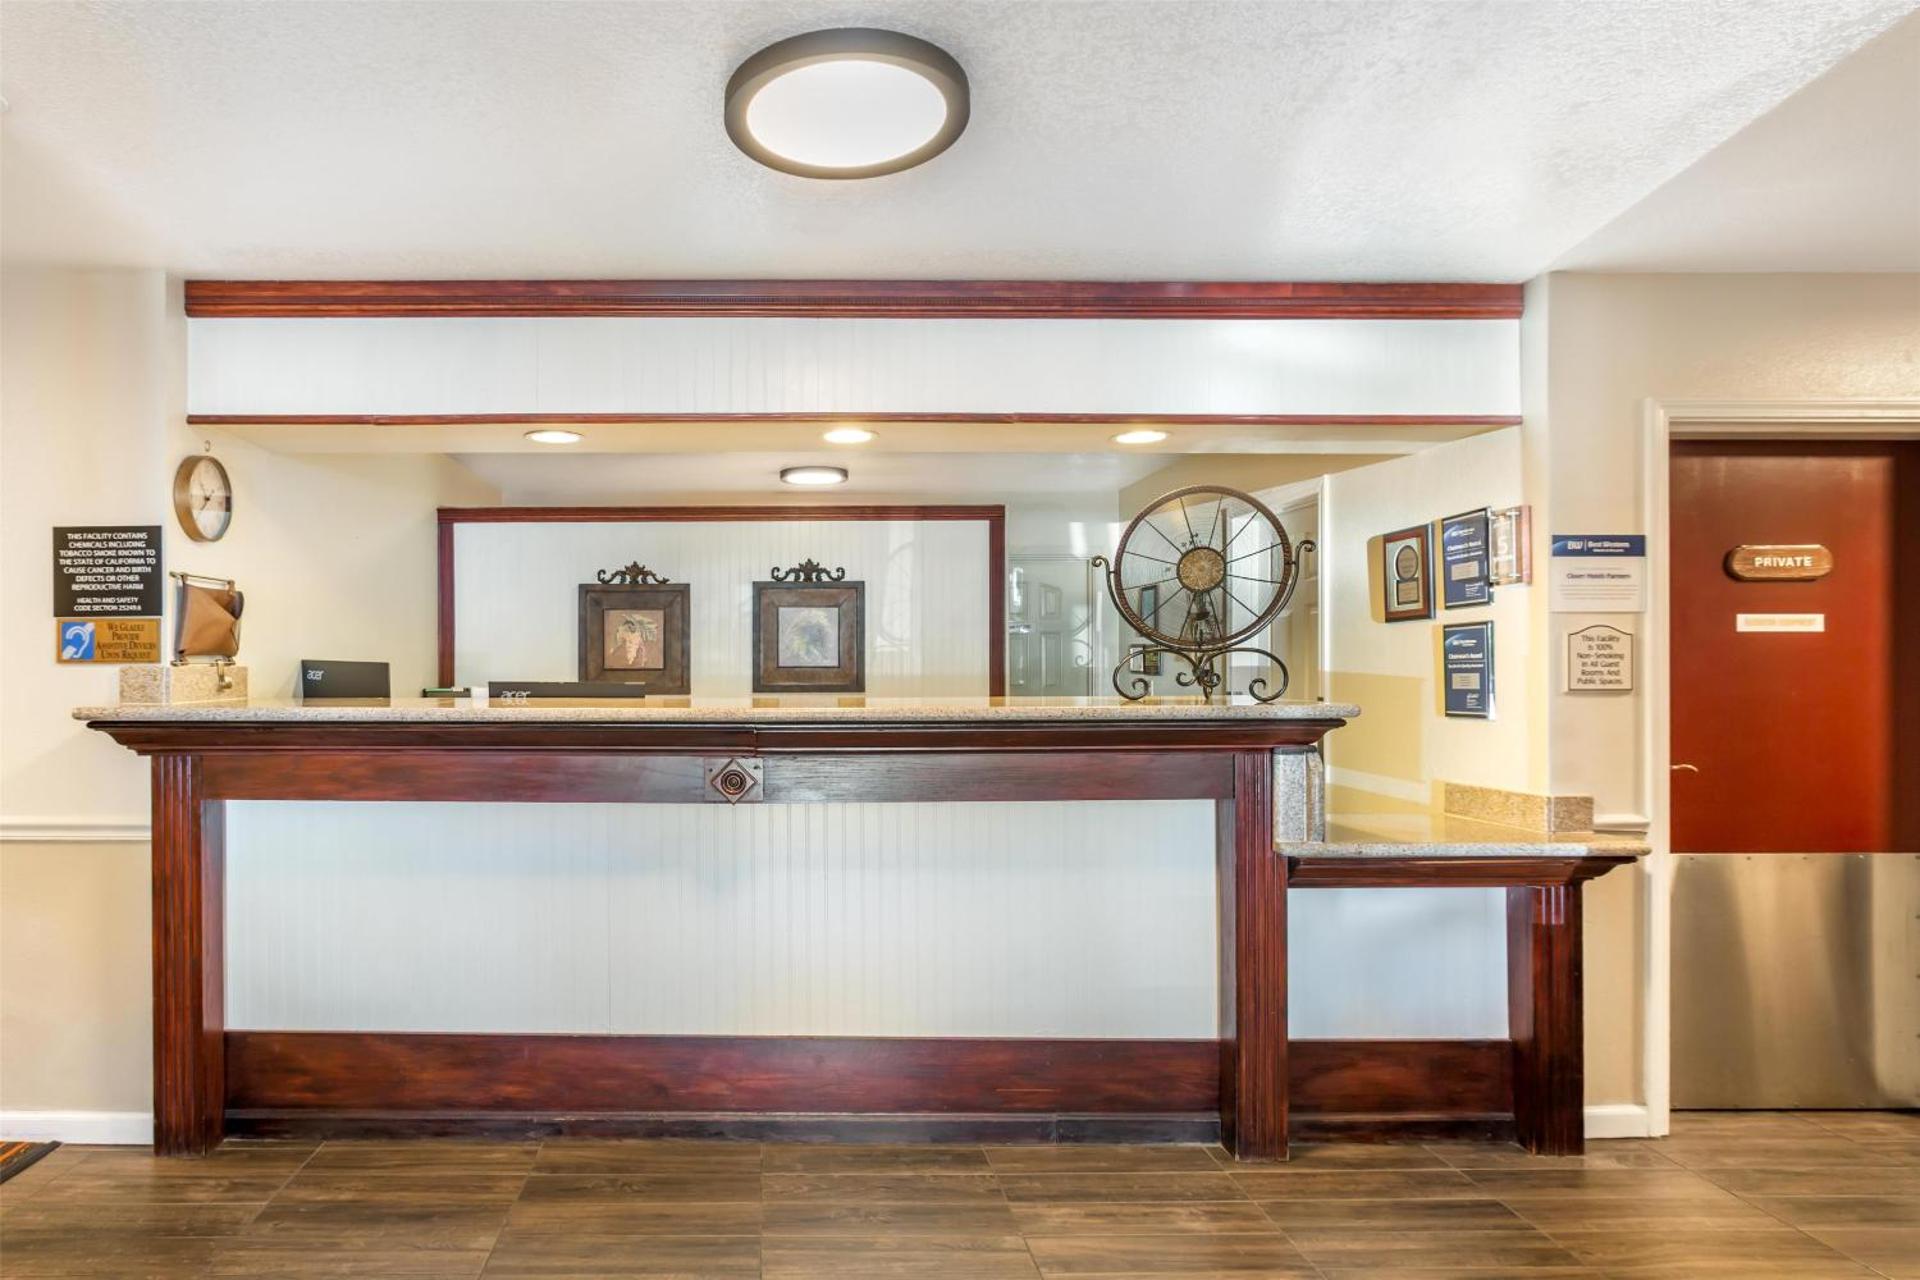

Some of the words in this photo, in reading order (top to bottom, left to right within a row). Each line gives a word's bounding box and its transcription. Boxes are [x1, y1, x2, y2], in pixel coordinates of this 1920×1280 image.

[60, 549, 92, 557] TOBACCO
[1754, 556, 1813, 568] PRIVATE
[306, 670, 324, 680] acer
[501, 691, 530, 700] acer
